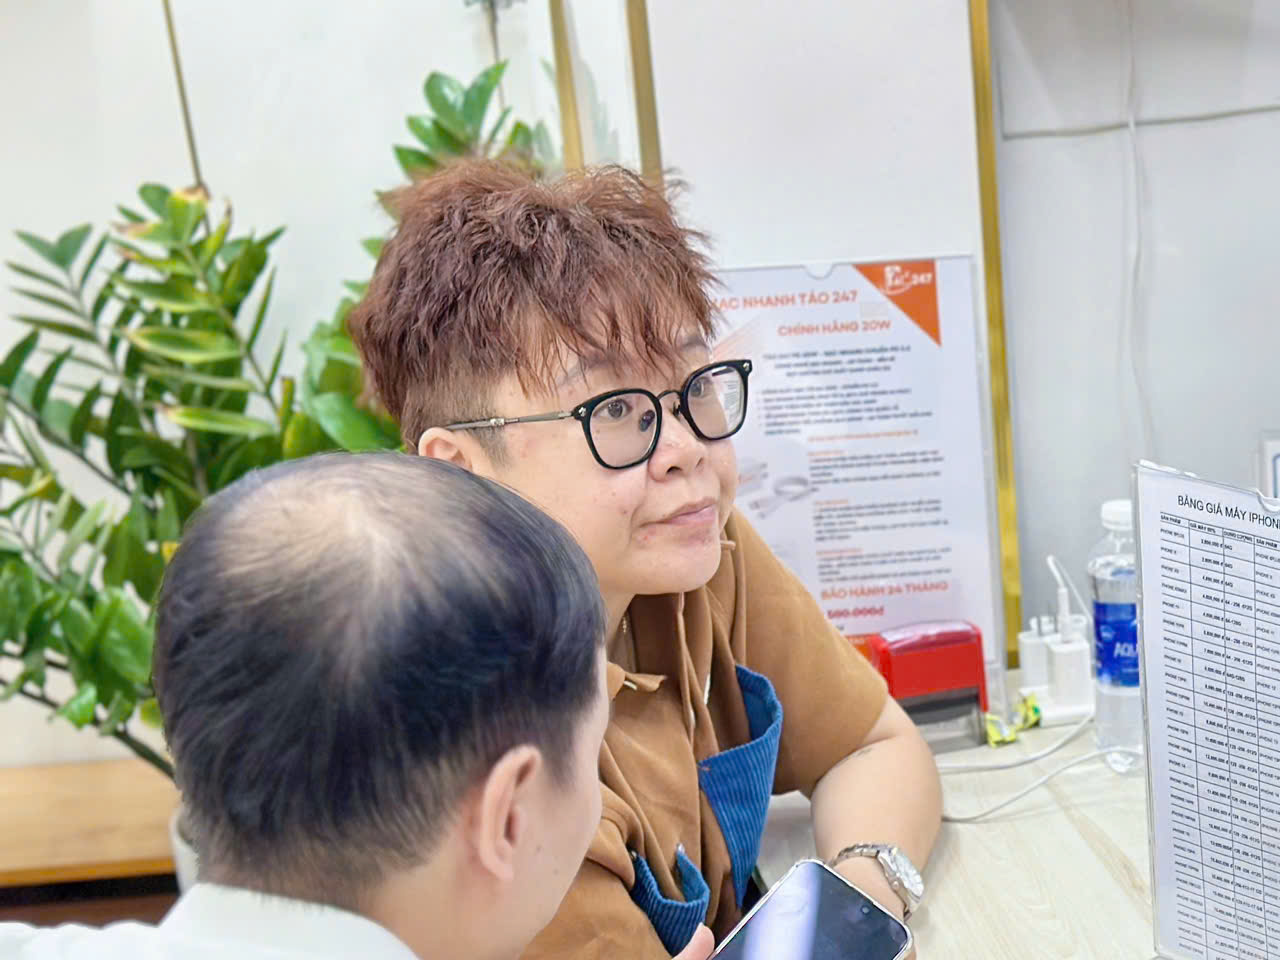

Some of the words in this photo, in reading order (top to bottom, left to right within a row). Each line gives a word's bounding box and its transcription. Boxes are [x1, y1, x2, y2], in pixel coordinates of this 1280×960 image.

[743, 294, 796, 309] NHANH
[799, 290, 829, 304] TÁO
[832, 290, 858, 303] 247
[777, 323, 820, 336] CHÍNH
[822, 320, 859, 334] HÃNG
[862, 319, 892, 331] 20W
[1177, 495, 1204, 511] BẢNG
[1205, 502, 1224, 516] GIÁ
[1224, 506, 1248, 521] MÁY
